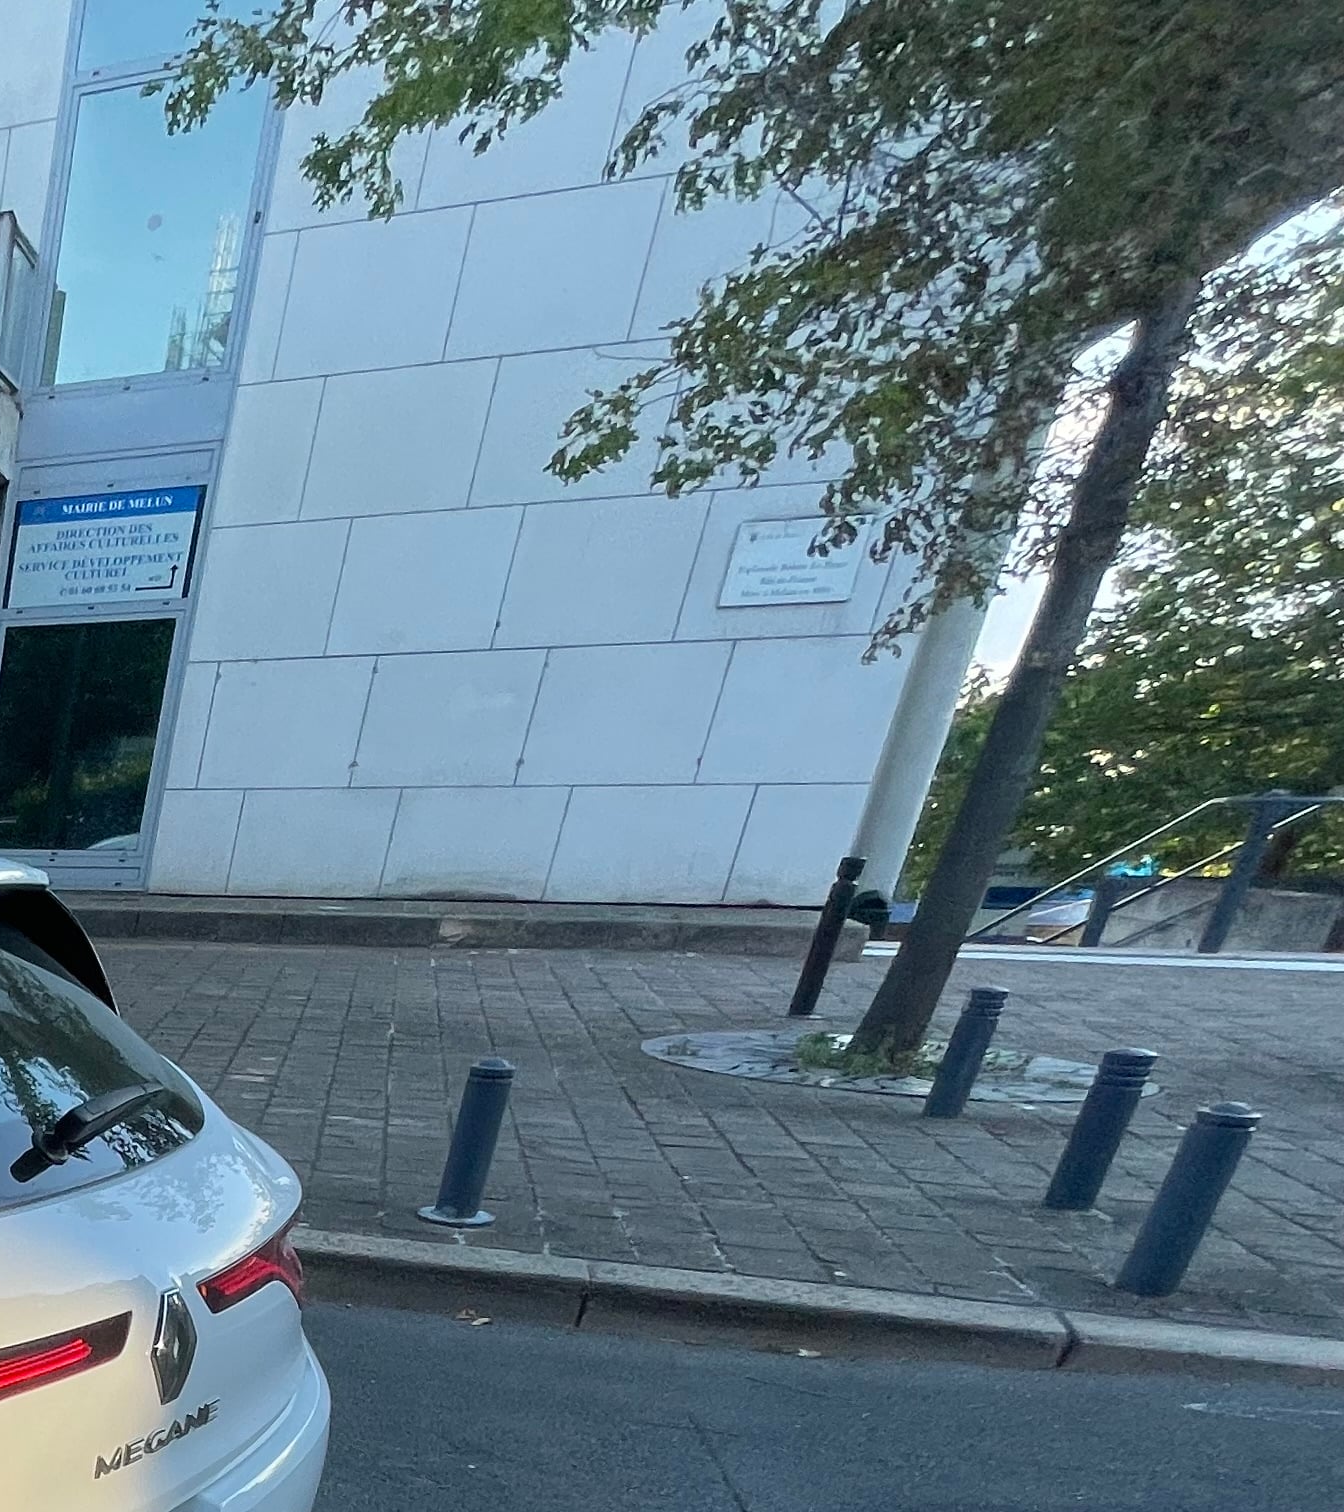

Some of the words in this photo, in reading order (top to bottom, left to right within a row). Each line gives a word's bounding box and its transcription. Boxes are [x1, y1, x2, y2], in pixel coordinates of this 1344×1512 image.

[62, 501, 107, 514] MAIRIE
[109, 499, 125, 511] DE
[129, 495, 173, 508] MELUN
[56, 526, 126, 540] DIRECTION
[129, 523, 152, 534] DES
[28, 539, 85, 554] AFFAIRES
[88, 532, 179, 549] CULTURELLES
[18, 559, 70, 573] SERVICE
[94, 1398, 221, 1480] MEGANE
